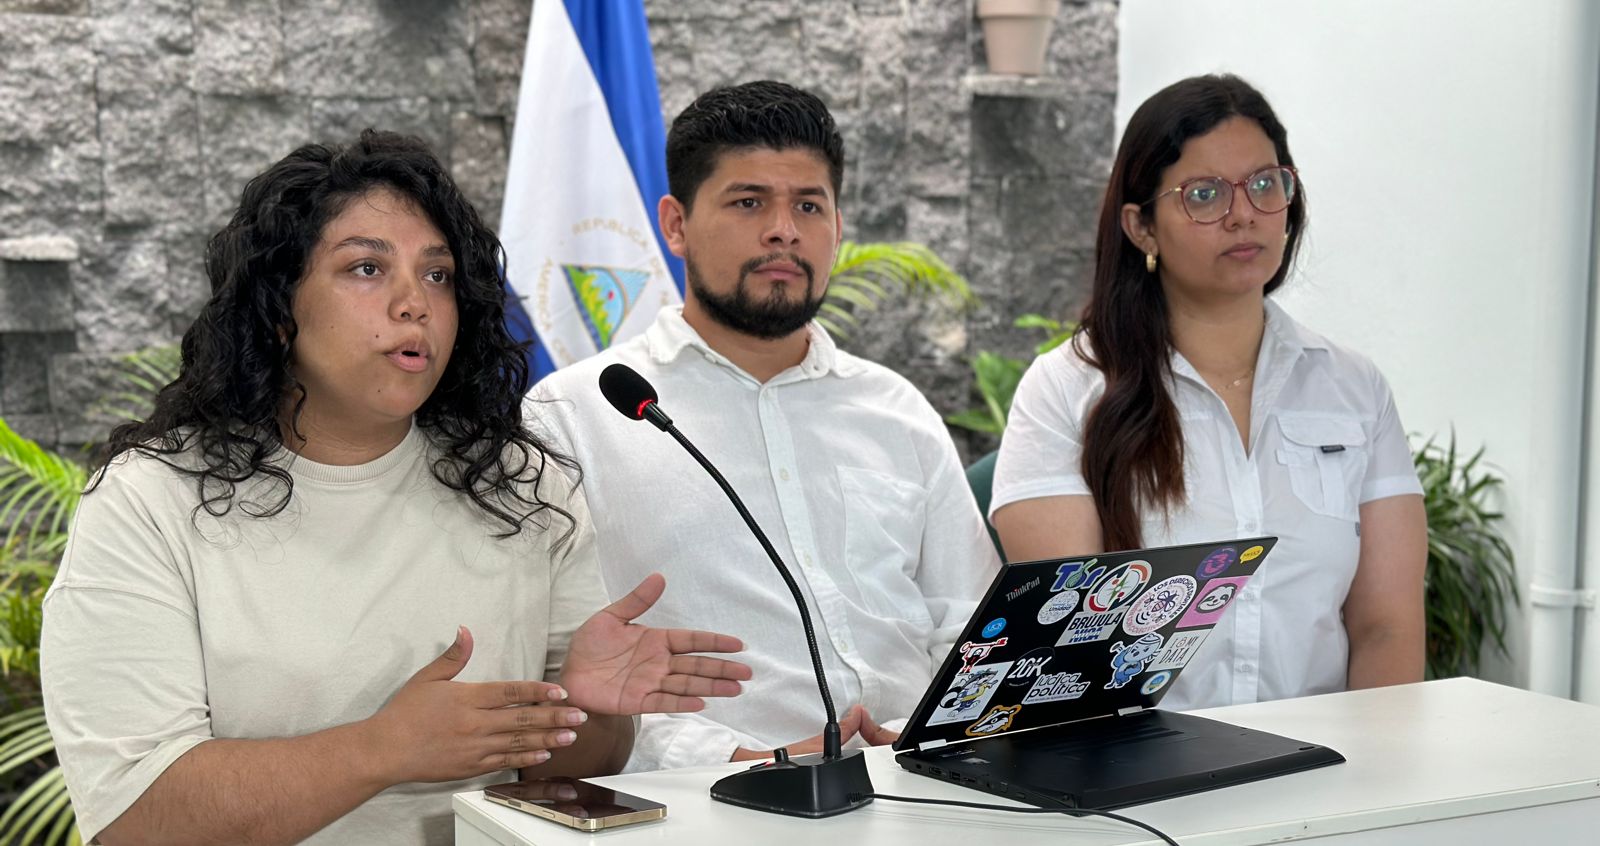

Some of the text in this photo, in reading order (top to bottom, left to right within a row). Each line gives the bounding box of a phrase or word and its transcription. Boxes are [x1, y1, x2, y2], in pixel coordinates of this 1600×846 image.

[1050, 559, 1106, 592] Tor
[1005, 576, 1040, 602] ThinkPad
[1153, 577, 1194, 618] LOS DERECHOS DIGITALES
[1067, 612, 1123, 631] BRÚJULA
[1184, 636, 1200, 647] MY
[1158, 647, 1190, 664] DATA
[1029, 680, 1089, 699] política
